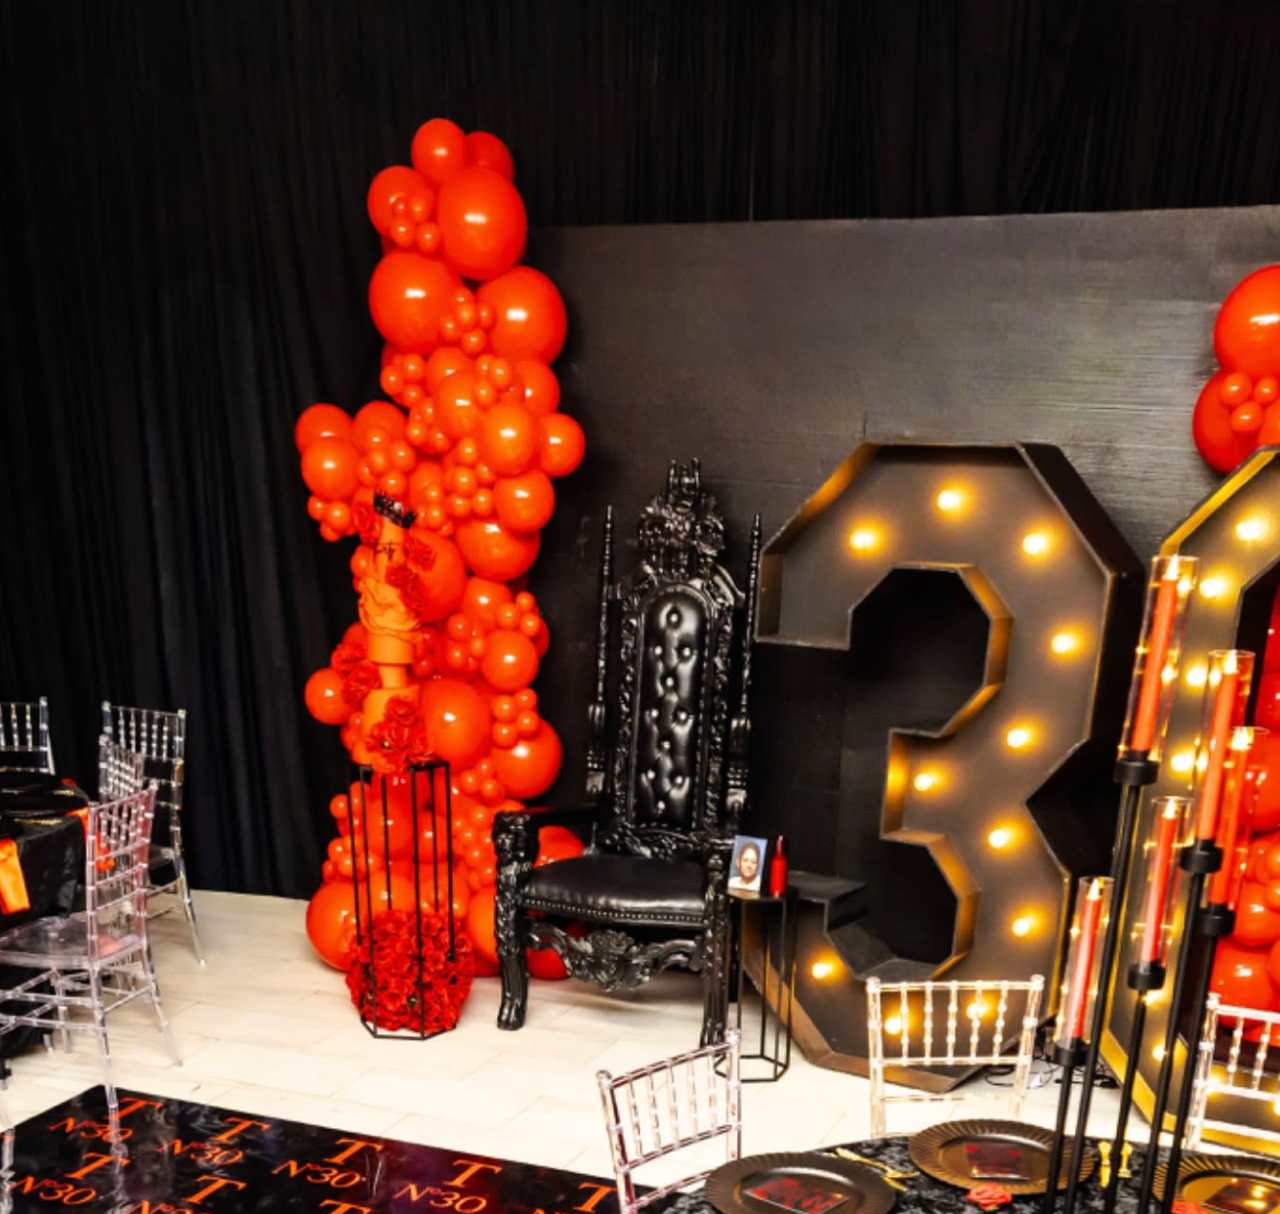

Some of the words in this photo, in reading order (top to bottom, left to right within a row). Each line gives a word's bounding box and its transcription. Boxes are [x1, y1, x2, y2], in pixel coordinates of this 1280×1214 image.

[107, 1096, 164, 1121] T
[211, 1116, 269, 1143] T
[65, 1151, 130, 1180] T
[322, 1137, 384, 1165] T
[444, 1159, 502, 1188] T
[182, 1174, 247, 1204] T
[573, 1182, 622, 1214] T
